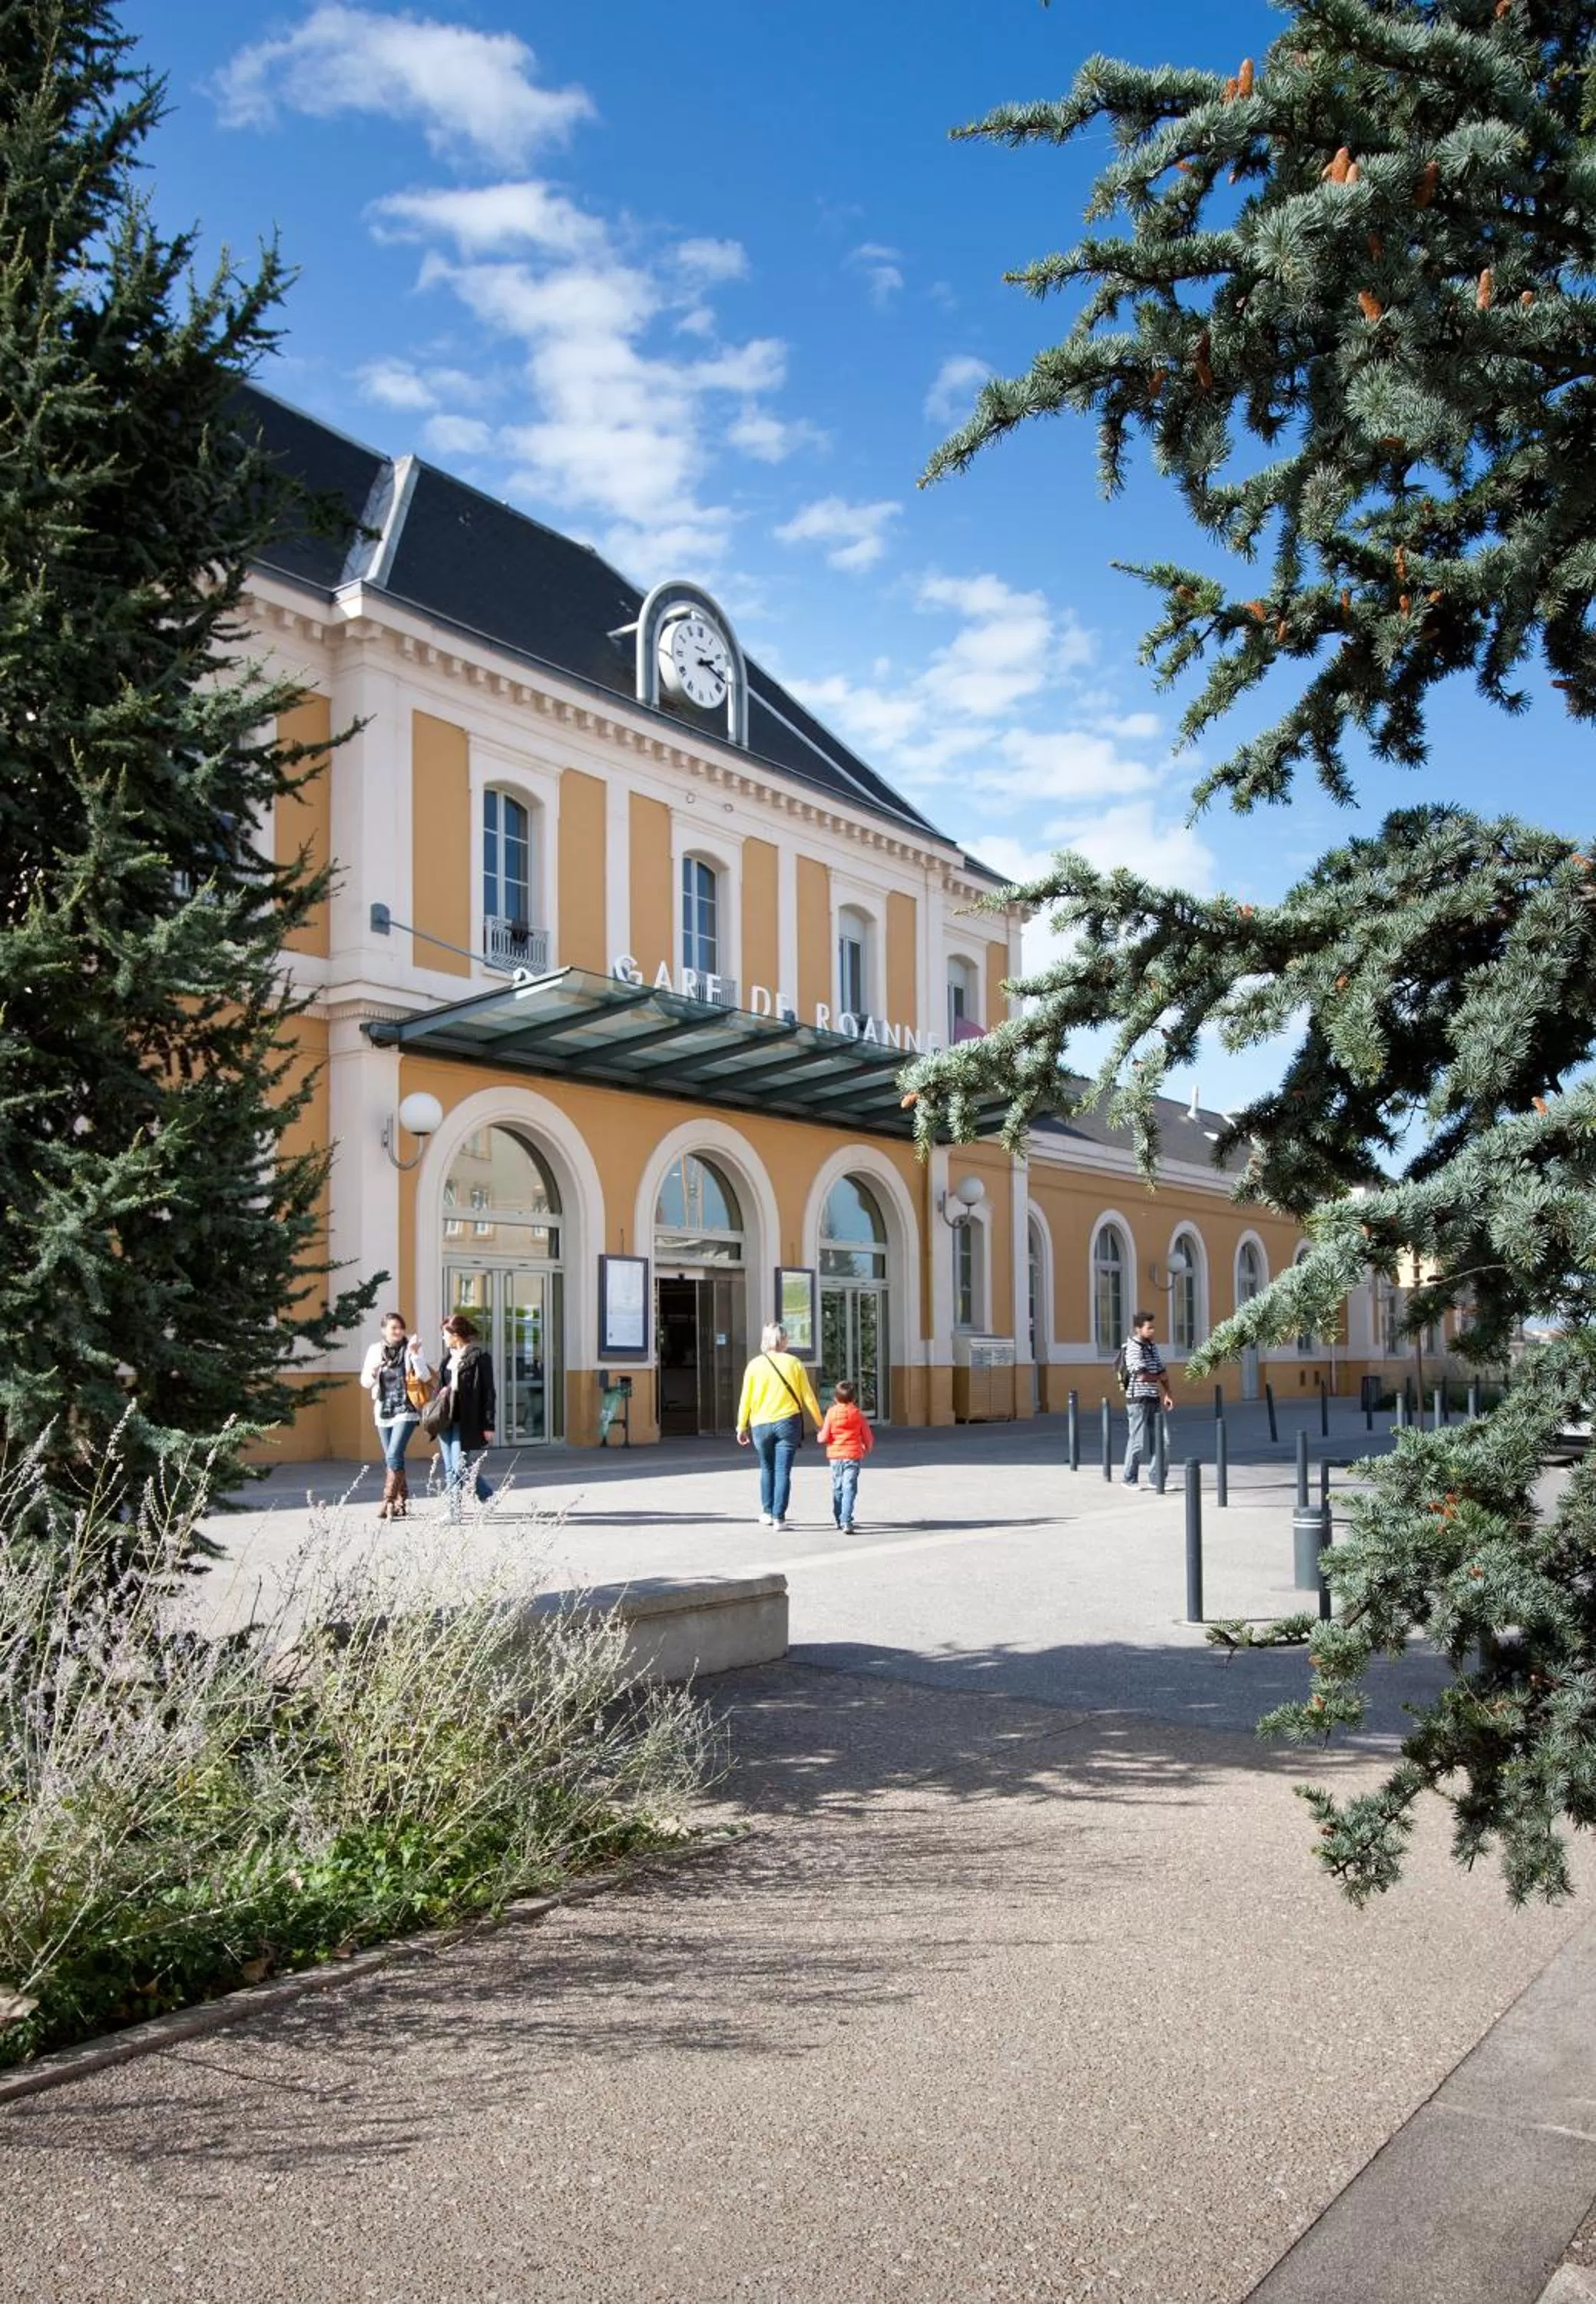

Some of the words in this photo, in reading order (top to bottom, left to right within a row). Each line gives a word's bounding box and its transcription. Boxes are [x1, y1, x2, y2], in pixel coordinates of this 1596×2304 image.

[614, 953, 722, 1001] GARE
[751, 984, 790, 1021] DE
[815, 1002, 942, 1052] ROANNE
